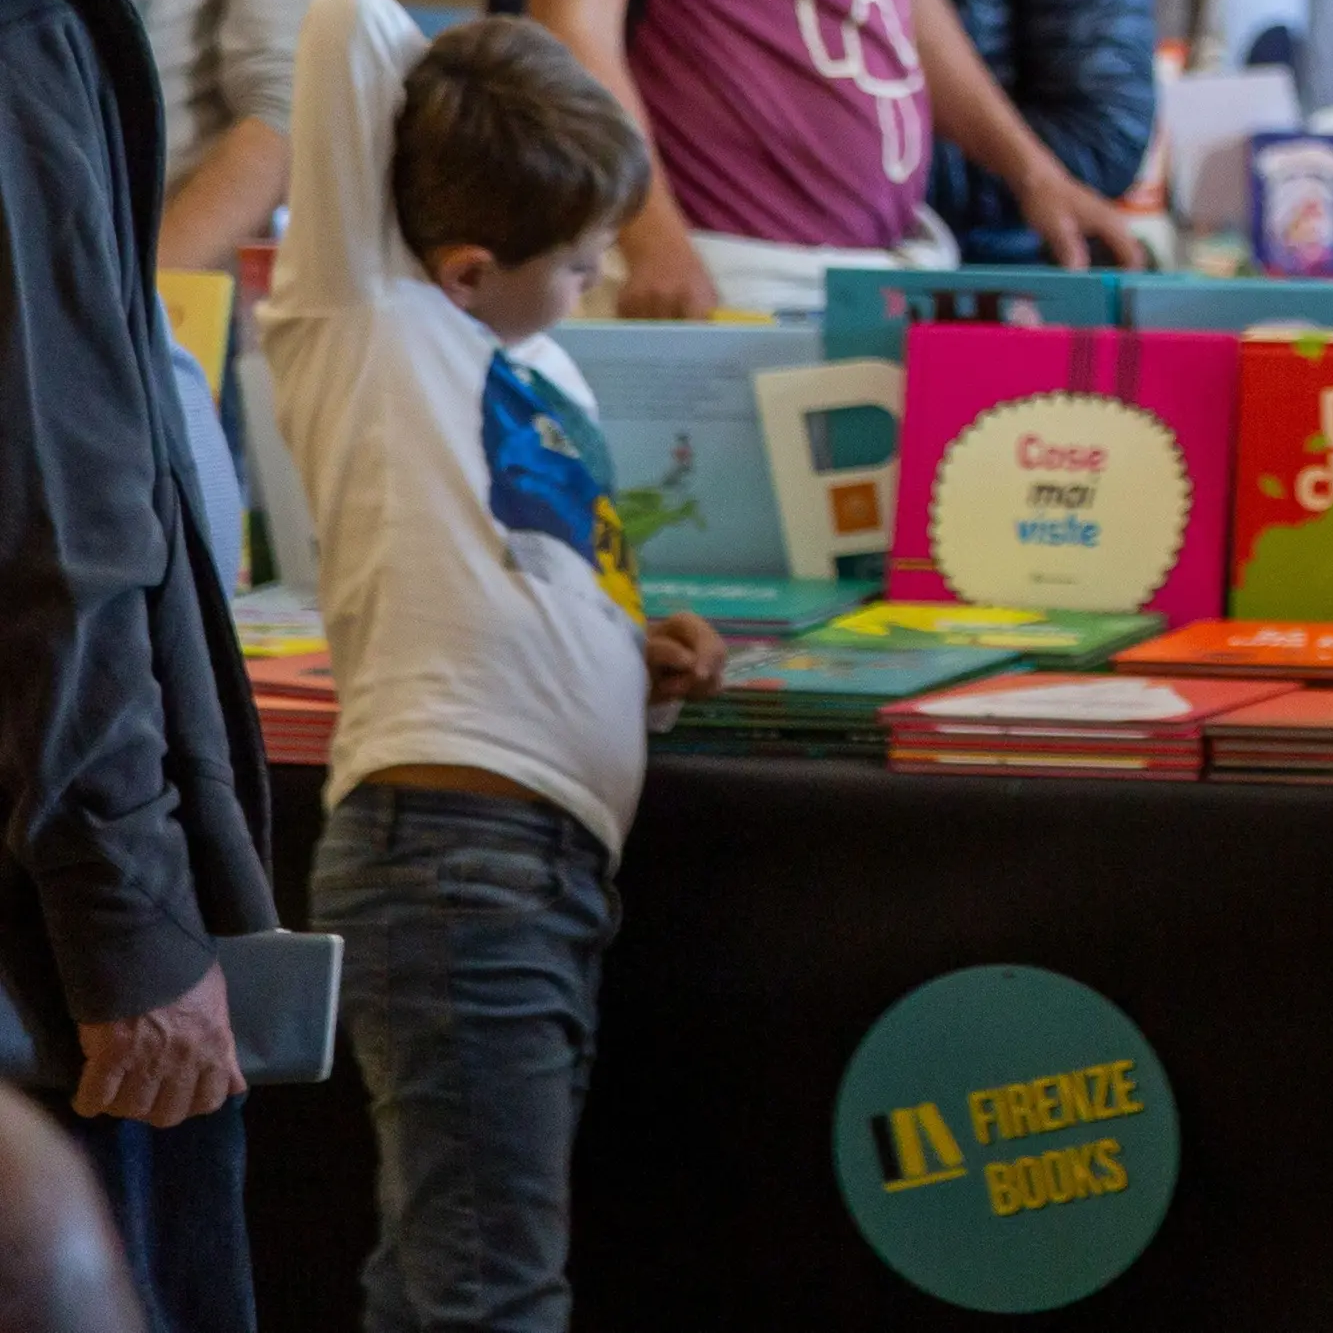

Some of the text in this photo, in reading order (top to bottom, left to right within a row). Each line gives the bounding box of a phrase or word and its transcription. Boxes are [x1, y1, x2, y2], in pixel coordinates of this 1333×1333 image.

[1017, 436, 1107, 471] Cose
[1027, 479, 1097, 509] mai
[1016, 514, 1101, 547] viste
[969, 1060, 1144, 1143] FIRENZE
[986, 1139, 1127, 1215] BOOKS
